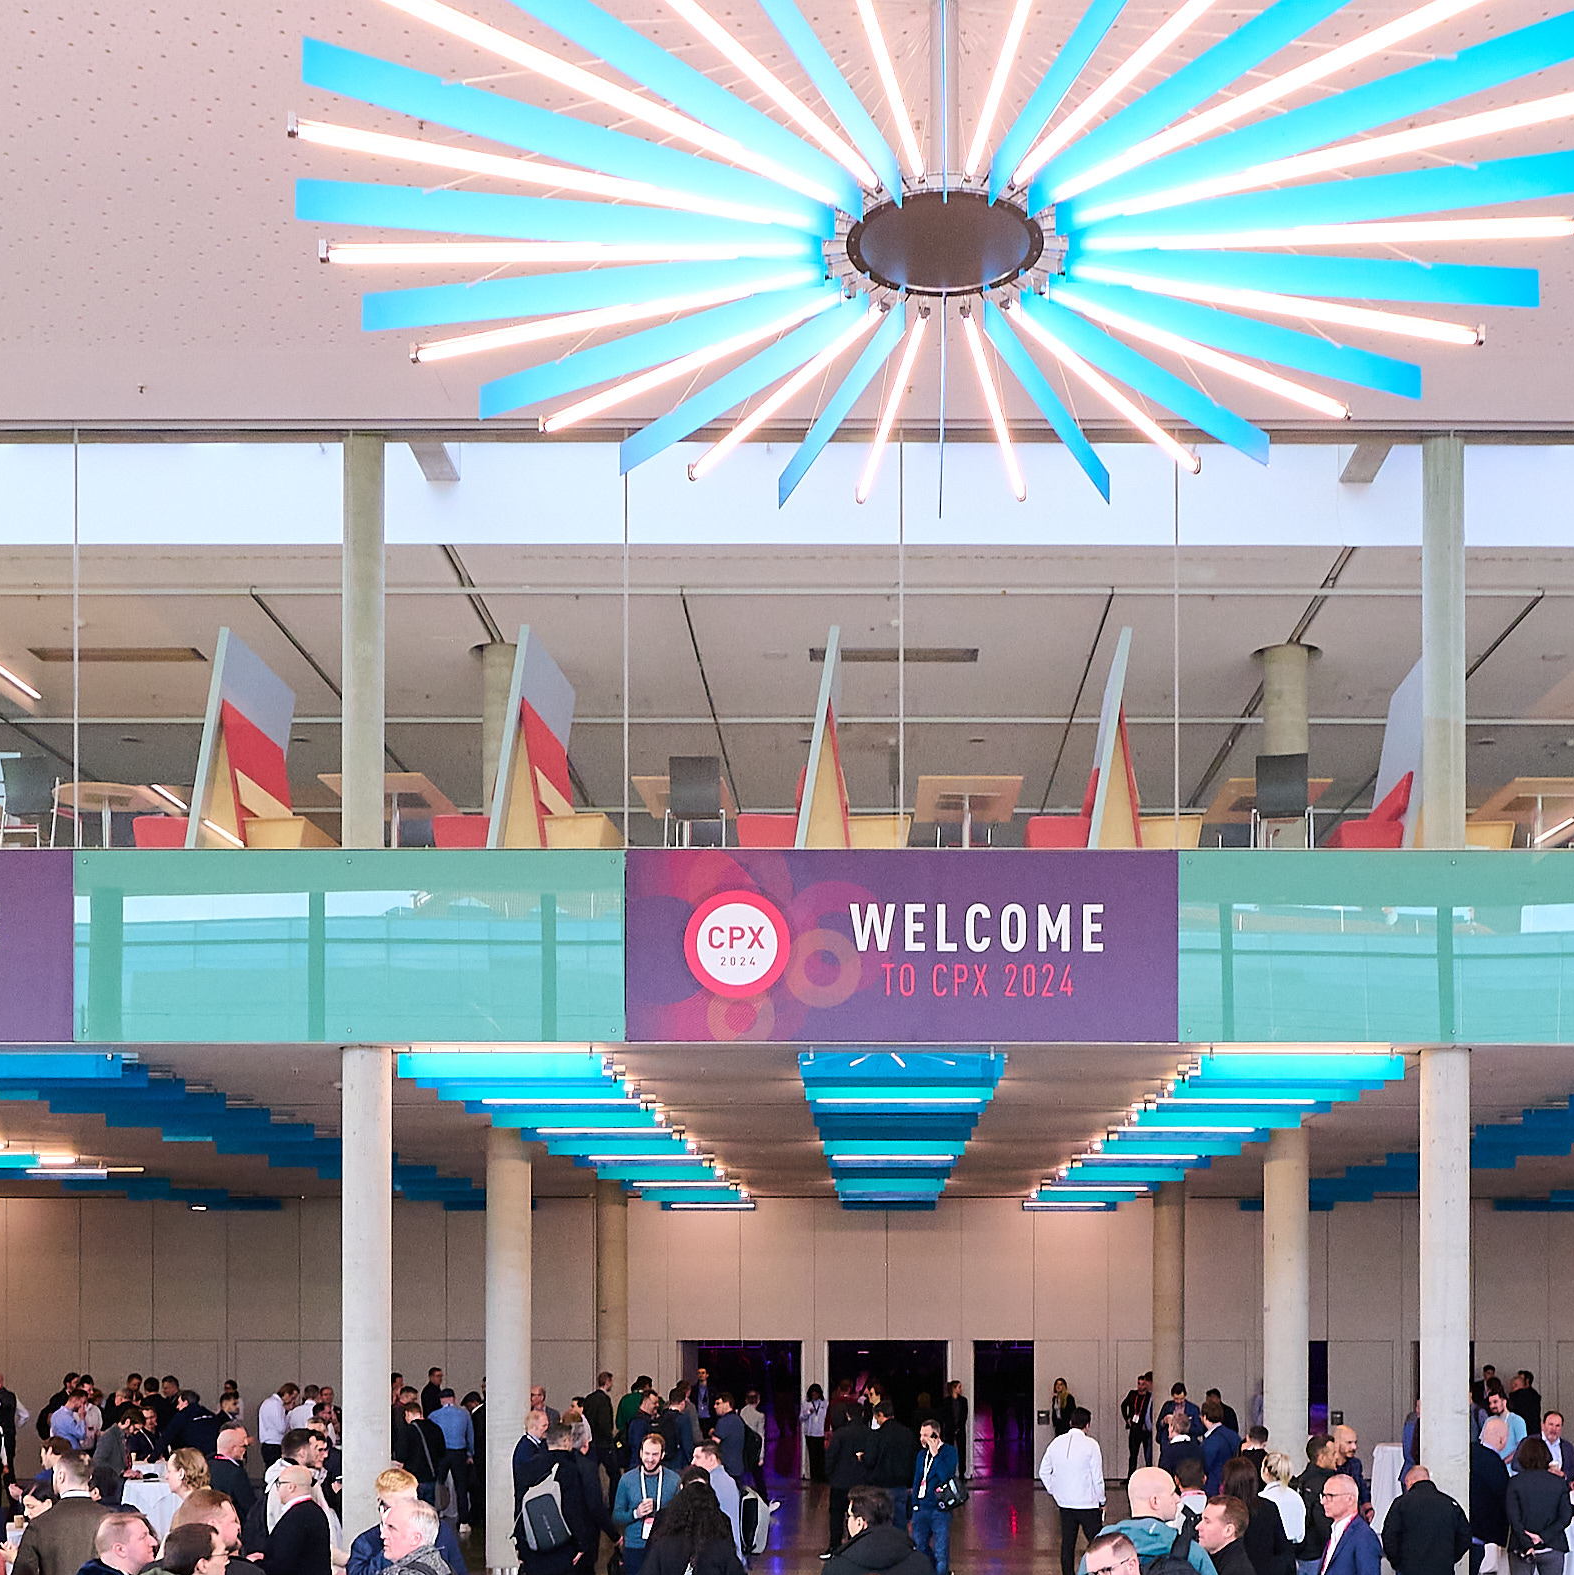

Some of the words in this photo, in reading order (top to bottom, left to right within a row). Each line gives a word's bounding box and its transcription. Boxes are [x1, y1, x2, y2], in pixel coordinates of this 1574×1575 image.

[708, 925, 765, 950] CPX
[849, 903, 1105, 952] WELCOME
[720, 956, 757, 967] 2024
[881, 963, 915, 997] TO
[932, 963, 988, 997] CPX
[1004, 963, 1074, 997] 2024
